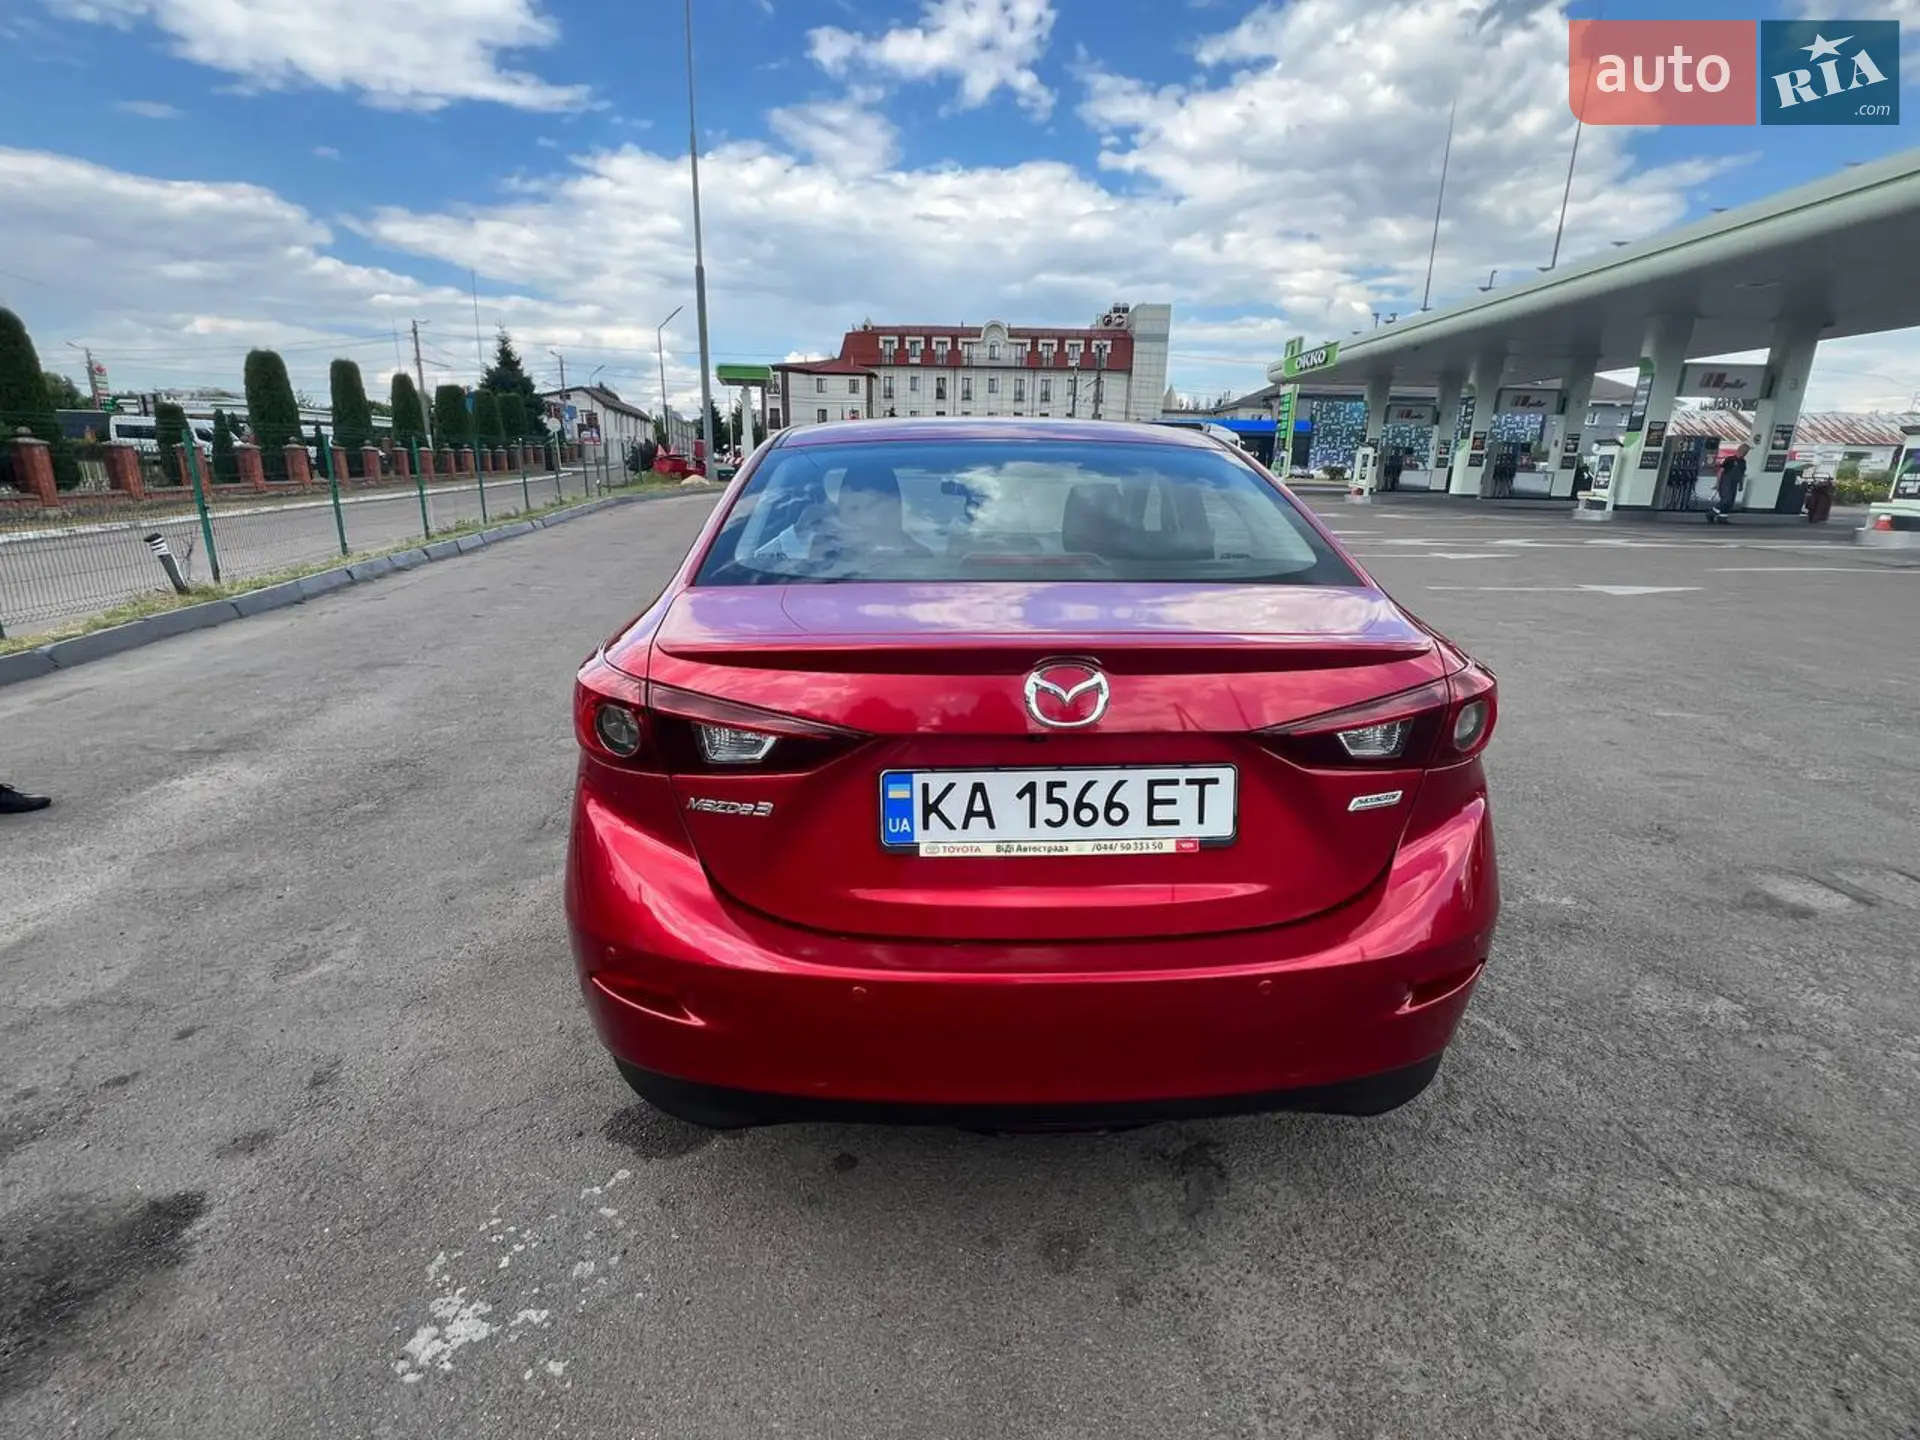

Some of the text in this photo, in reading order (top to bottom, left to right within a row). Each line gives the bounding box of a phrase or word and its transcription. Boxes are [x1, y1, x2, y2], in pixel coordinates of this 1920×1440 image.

[1295, 349, 1327, 371] OKKO
[921, 777, 1220, 831] KA 1566 ET
[888, 818, 911, 833] UA
[942, 845, 982, 854] TOYOTA
